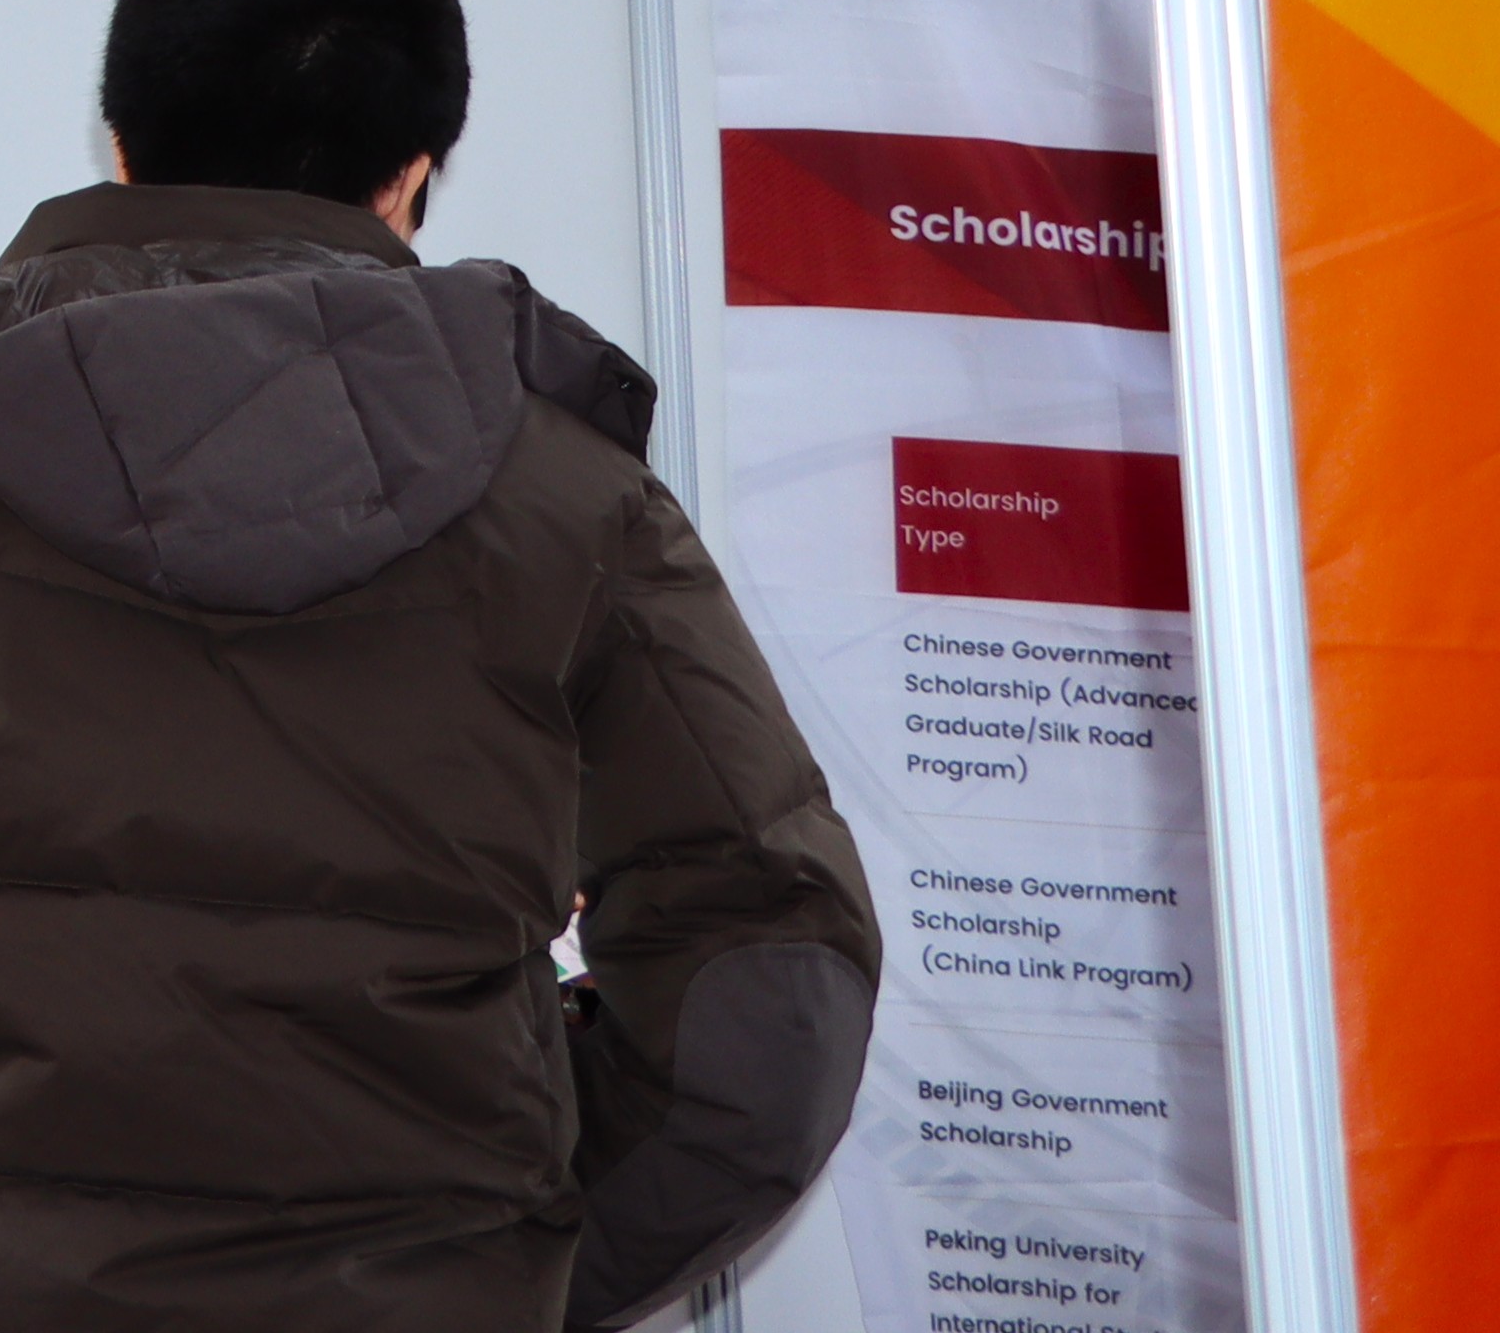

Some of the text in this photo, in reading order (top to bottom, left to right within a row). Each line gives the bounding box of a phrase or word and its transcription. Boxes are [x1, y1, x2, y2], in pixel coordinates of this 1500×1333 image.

[889, 203, 1169, 272] Scholarship
[899, 484, 1059, 519] Scholarship
[901, 523, 964, 553] Type
[903, 633, 1172, 672] Chinese Government
[904, 673, 1051, 707] Scholarship
[905, 713, 1153, 749] Graduate/Silk Road
[906, 752, 1028, 784] Program)
[910, 868, 1177, 907] Chinese Government
[911, 908, 1061, 942] Scholarship
[921, 943, 1192, 994] (China Link Program)
[918, 1079, 1169, 1120] Beijing Government
[919, 1121, 1072, 1155] Scholarship
[925, 1228, 1146, 1273] Peking University
[927, 1270, 1122, 1306] Scholarship for
